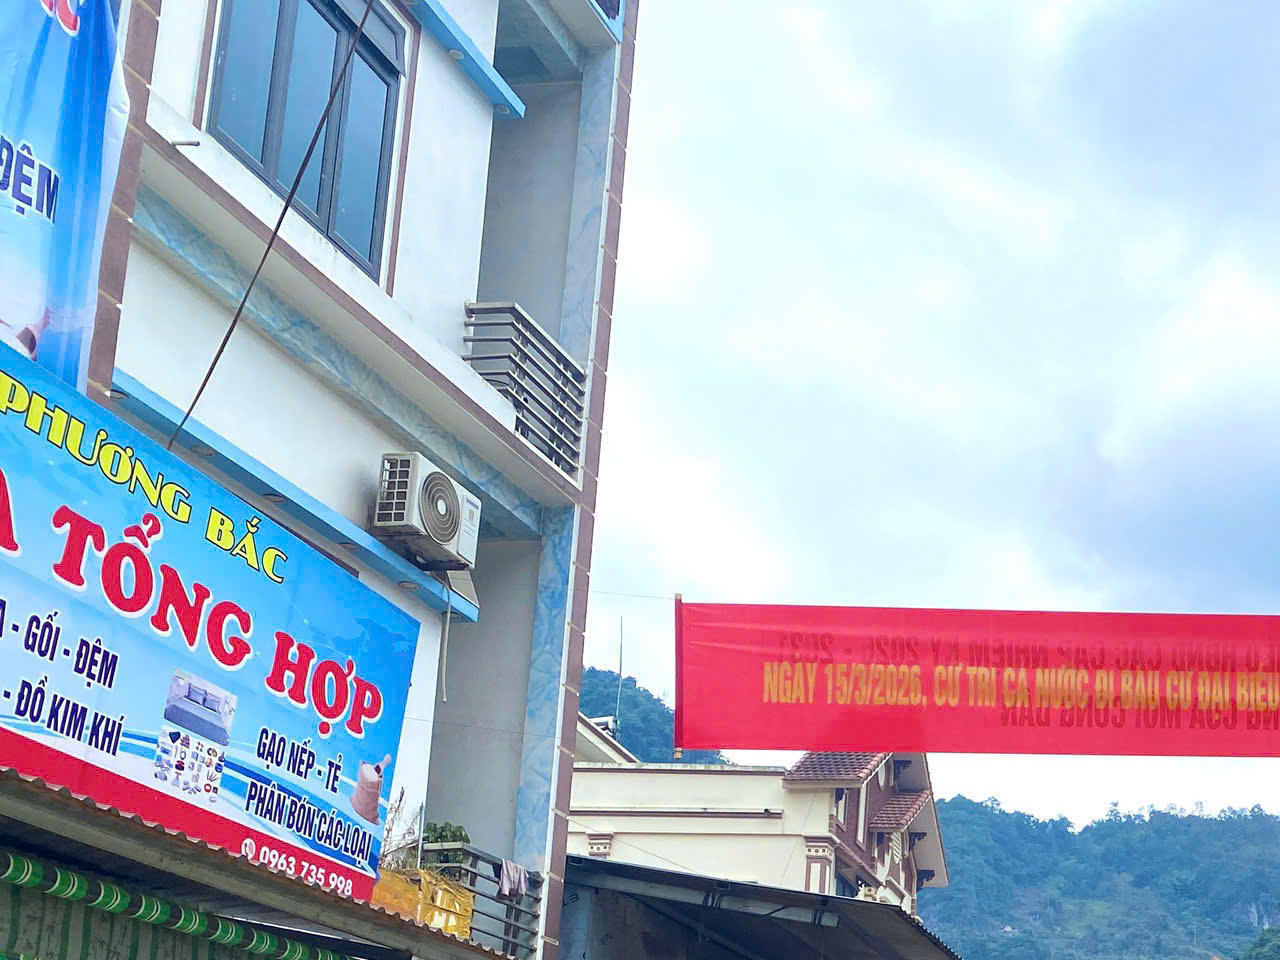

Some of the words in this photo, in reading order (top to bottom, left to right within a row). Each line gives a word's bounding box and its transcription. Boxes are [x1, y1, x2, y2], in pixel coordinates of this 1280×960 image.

[0, 369, 192, 524] PHƯƠNG
[205, 506, 288, 584] BẮC
[24, 611, 60, 662] GỐI
[74, 638, 118, 689] ĐỆM
[52, 504, 252, 667] TỔNG
[266, 631, 383, 736] HỢP
[15, 676, 48, 723] ĐỒ
[47, 694, 88, 742] KIM
[88, 716, 124, 756] KHÍ
[256, 728, 288, 769] GẠO
[287, 740, 316, 780] NẾP
[324, 754, 342, 793] TẺ
[245, 781, 285, 826] PHÂN
[285, 797, 319, 839] BÓN
[317, 811, 343, 849] CÁC
[342, 822, 372, 867] LOẠI
[259, 846, 296, 875] 0963
[300, 860, 326, 885] 735
[328, 872, 353, 896] 998
